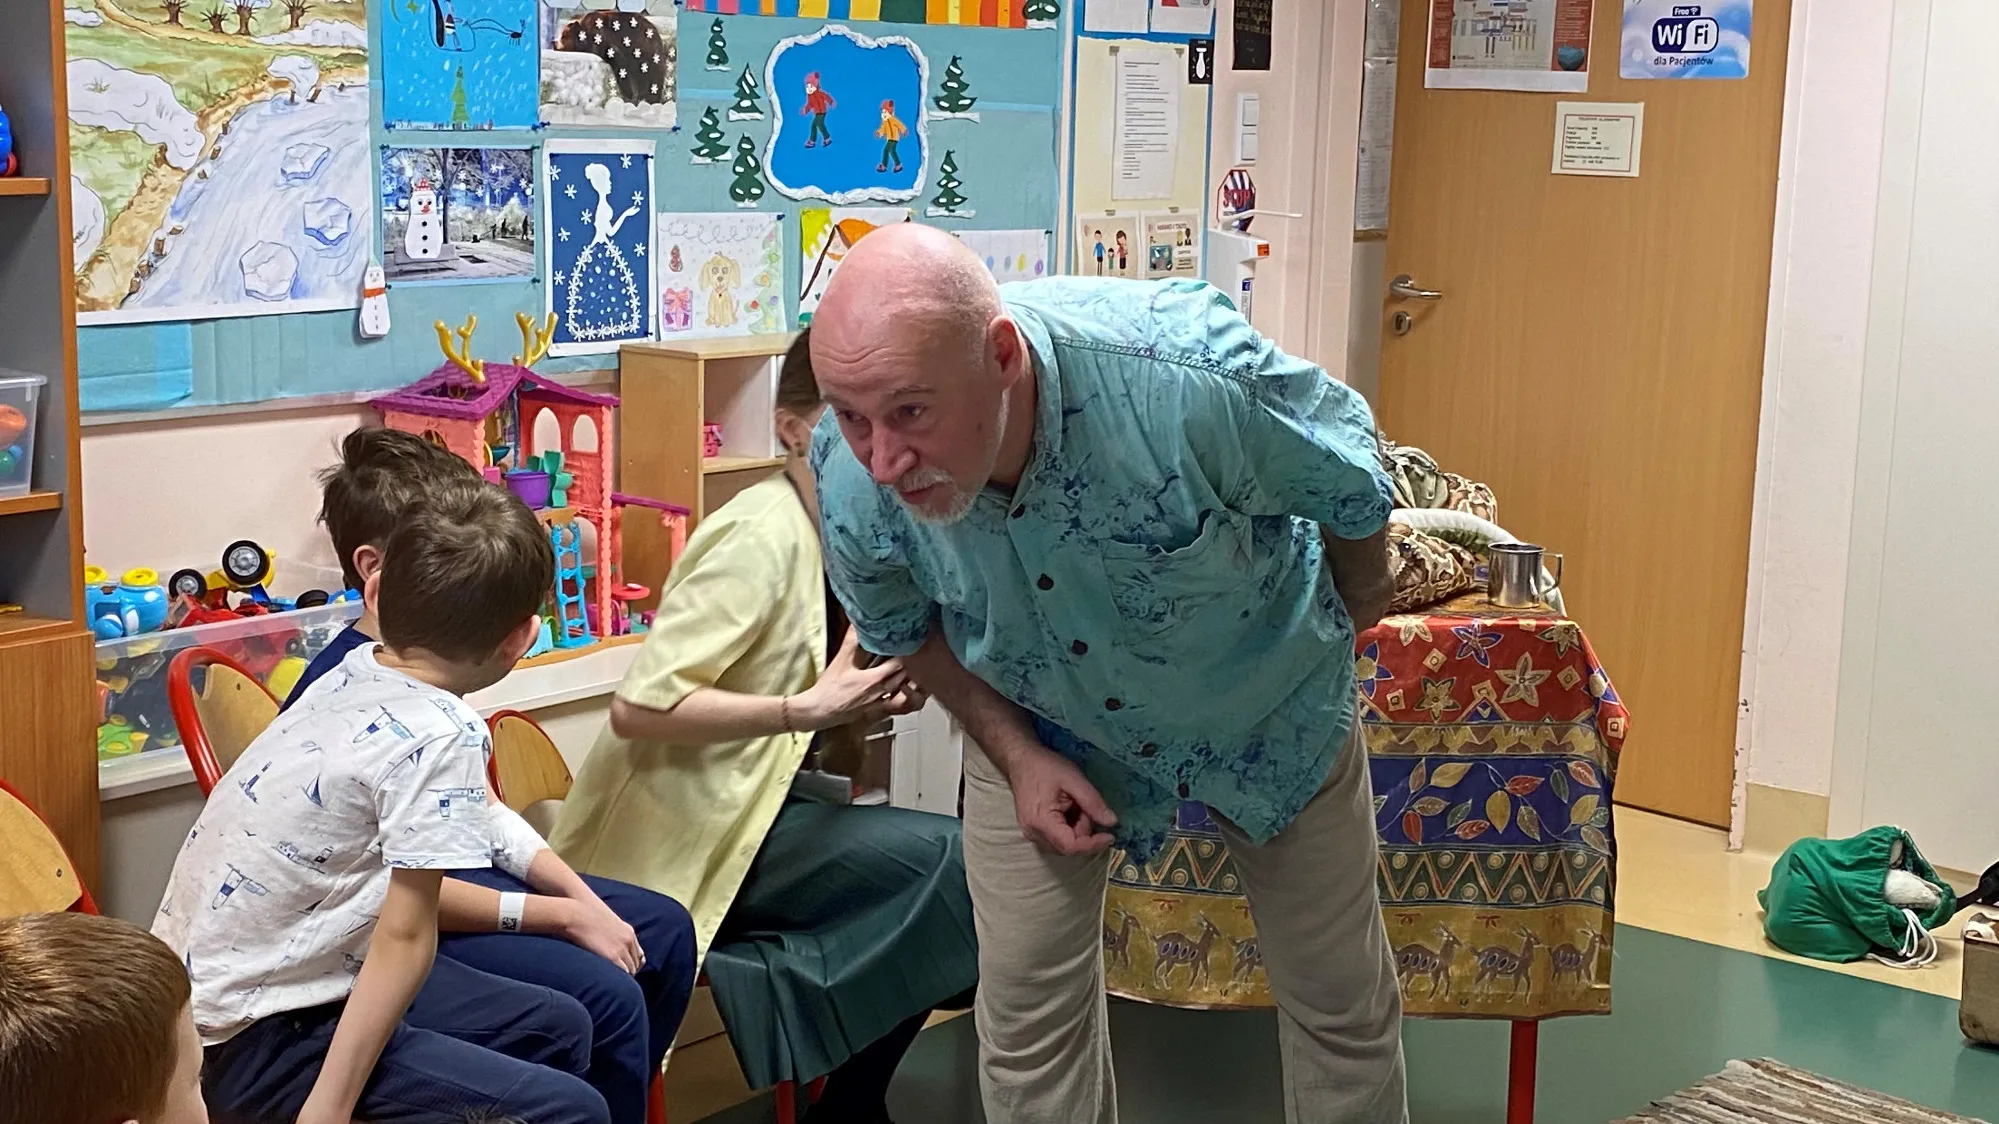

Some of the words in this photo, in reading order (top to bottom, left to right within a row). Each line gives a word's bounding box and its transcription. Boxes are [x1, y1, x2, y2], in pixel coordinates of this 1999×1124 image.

[1674, 7, 1690, 15] Free
[1653, 56, 1667, 66] dla
[1669, 56, 1714, 67] Pacjentów
